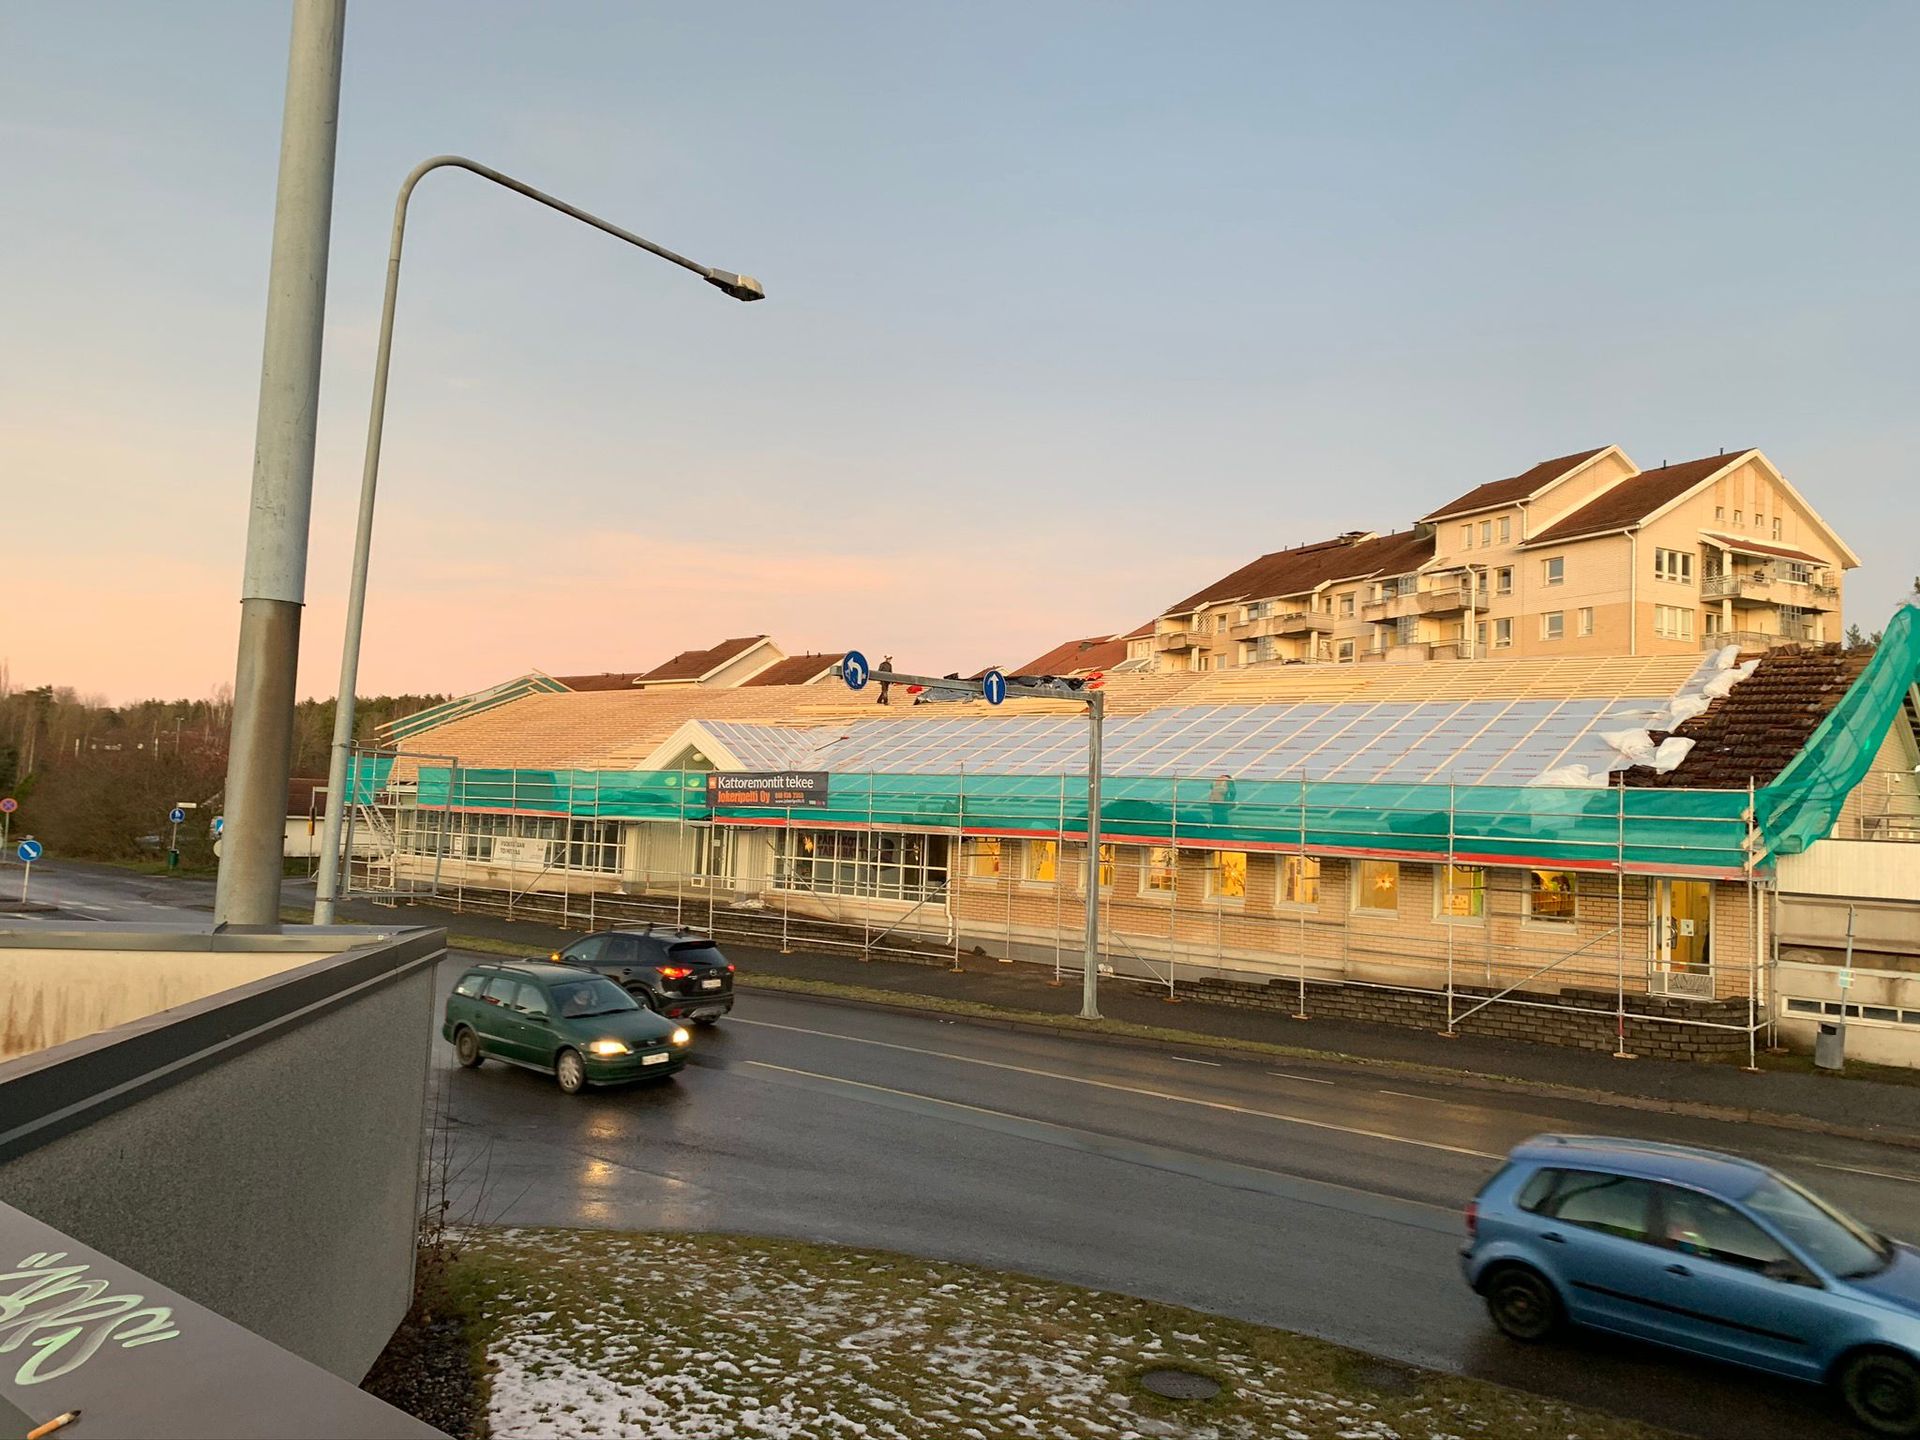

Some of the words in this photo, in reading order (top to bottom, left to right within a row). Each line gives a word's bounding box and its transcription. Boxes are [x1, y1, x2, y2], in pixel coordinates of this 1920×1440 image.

[718, 775, 784, 789] Kattoremontit
[785, 776, 814, 789] tekee
[760, 791, 770, 804] Oy
